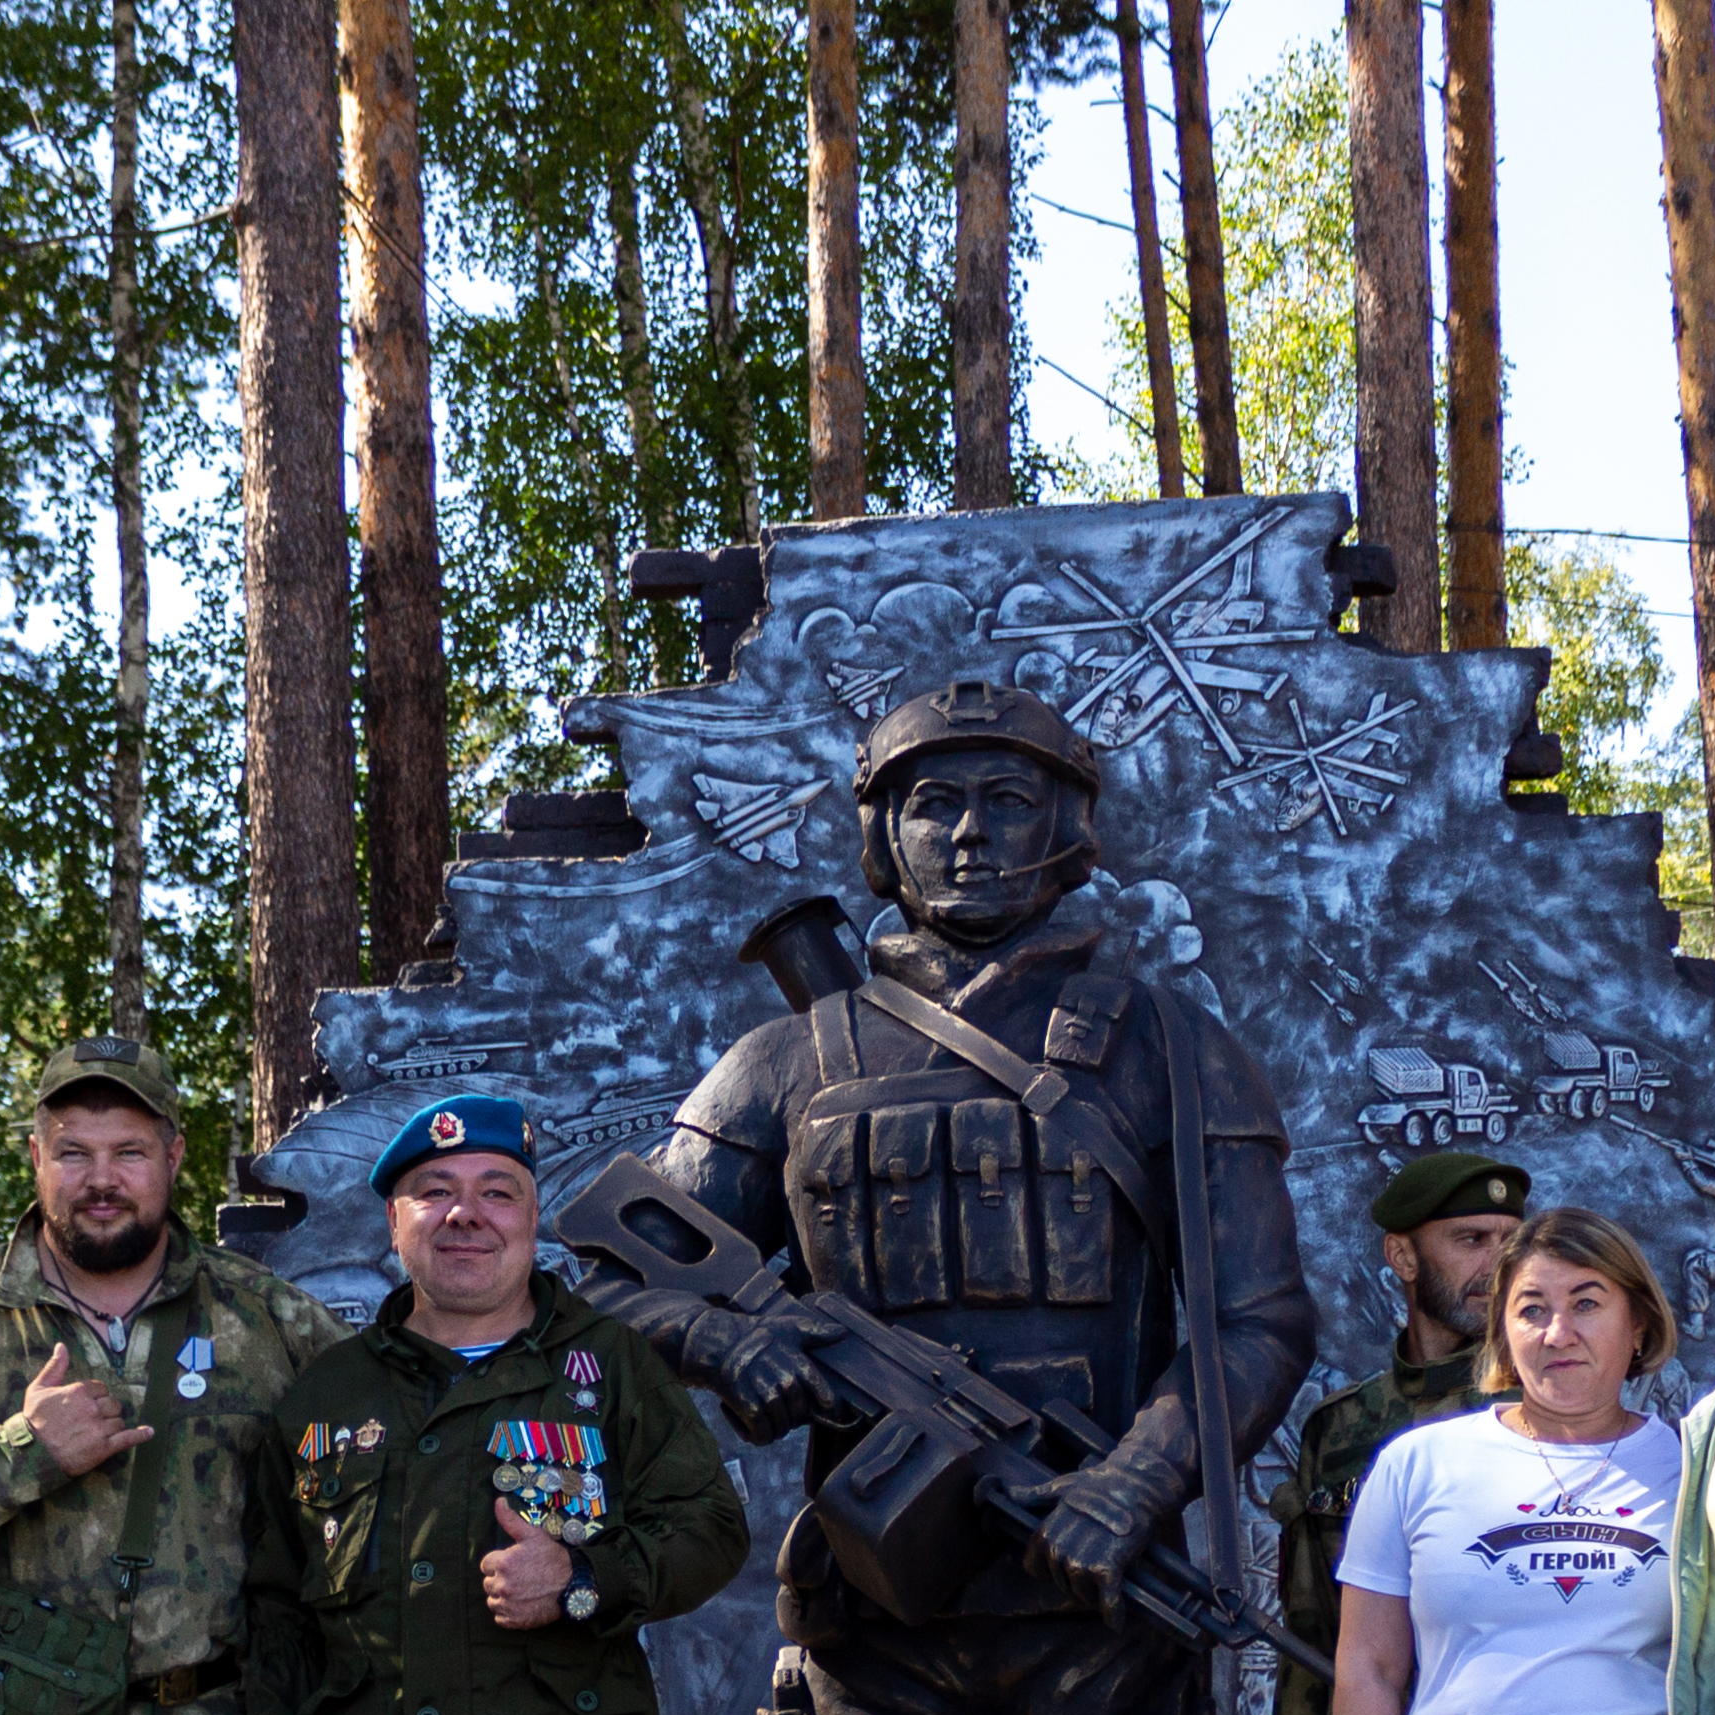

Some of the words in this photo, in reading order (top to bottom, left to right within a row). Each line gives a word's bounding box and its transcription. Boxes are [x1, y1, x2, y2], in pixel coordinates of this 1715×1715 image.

[1539, 1493, 1610, 1517] Мой
[1521, 1524, 1620, 1543] СЫН
[1529, 1549, 1616, 1570] ГЕРОЙ!
